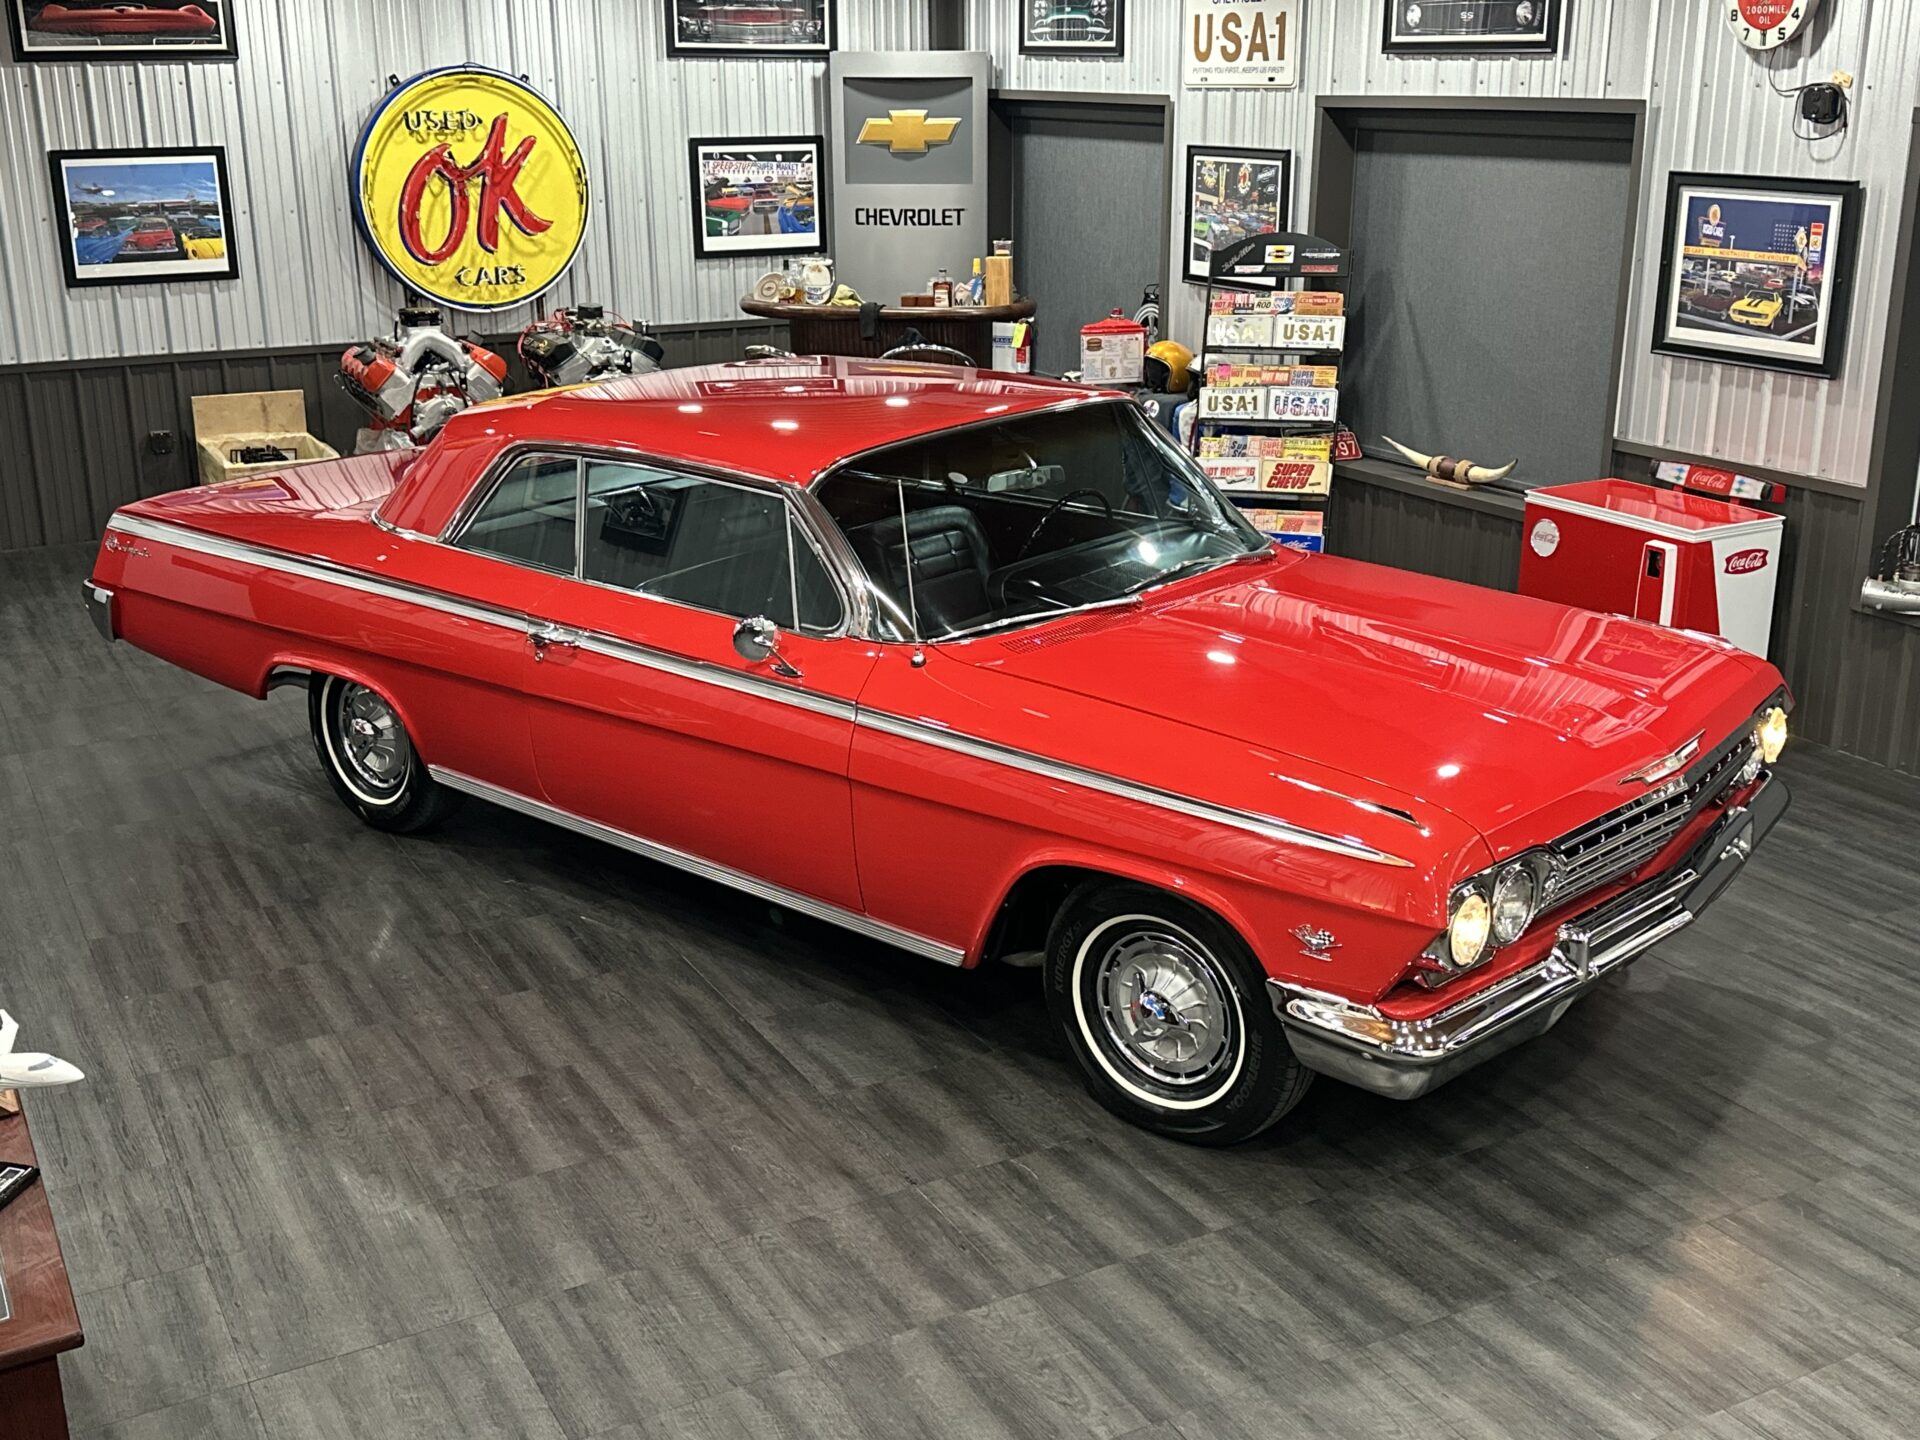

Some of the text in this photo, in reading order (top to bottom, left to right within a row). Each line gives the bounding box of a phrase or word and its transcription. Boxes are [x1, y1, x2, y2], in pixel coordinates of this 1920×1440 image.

[1731, 9, 1738, 21] 8
[1759, 16, 1771, 24] OIL
[1791, 7, 1800, 20] 4
[1743, 28, 1750, 40] 7
[1777, 27, 1786, 40] 5
[403, 109, 482, 132] USED
[398, 111, 554, 267] OK
[854, 207, 966, 226] CHEVROLET
[1754, 252, 1790, 261] CHEVROLET
[454, 264, 526, 287] CARS
[1256, 301, 1271, 309] ROD
[1292, 370, 1314, 378] SUPER
[1272, 462, 1316, 477] SUPER
[1266, 475, 1310, 489] CHEVY
